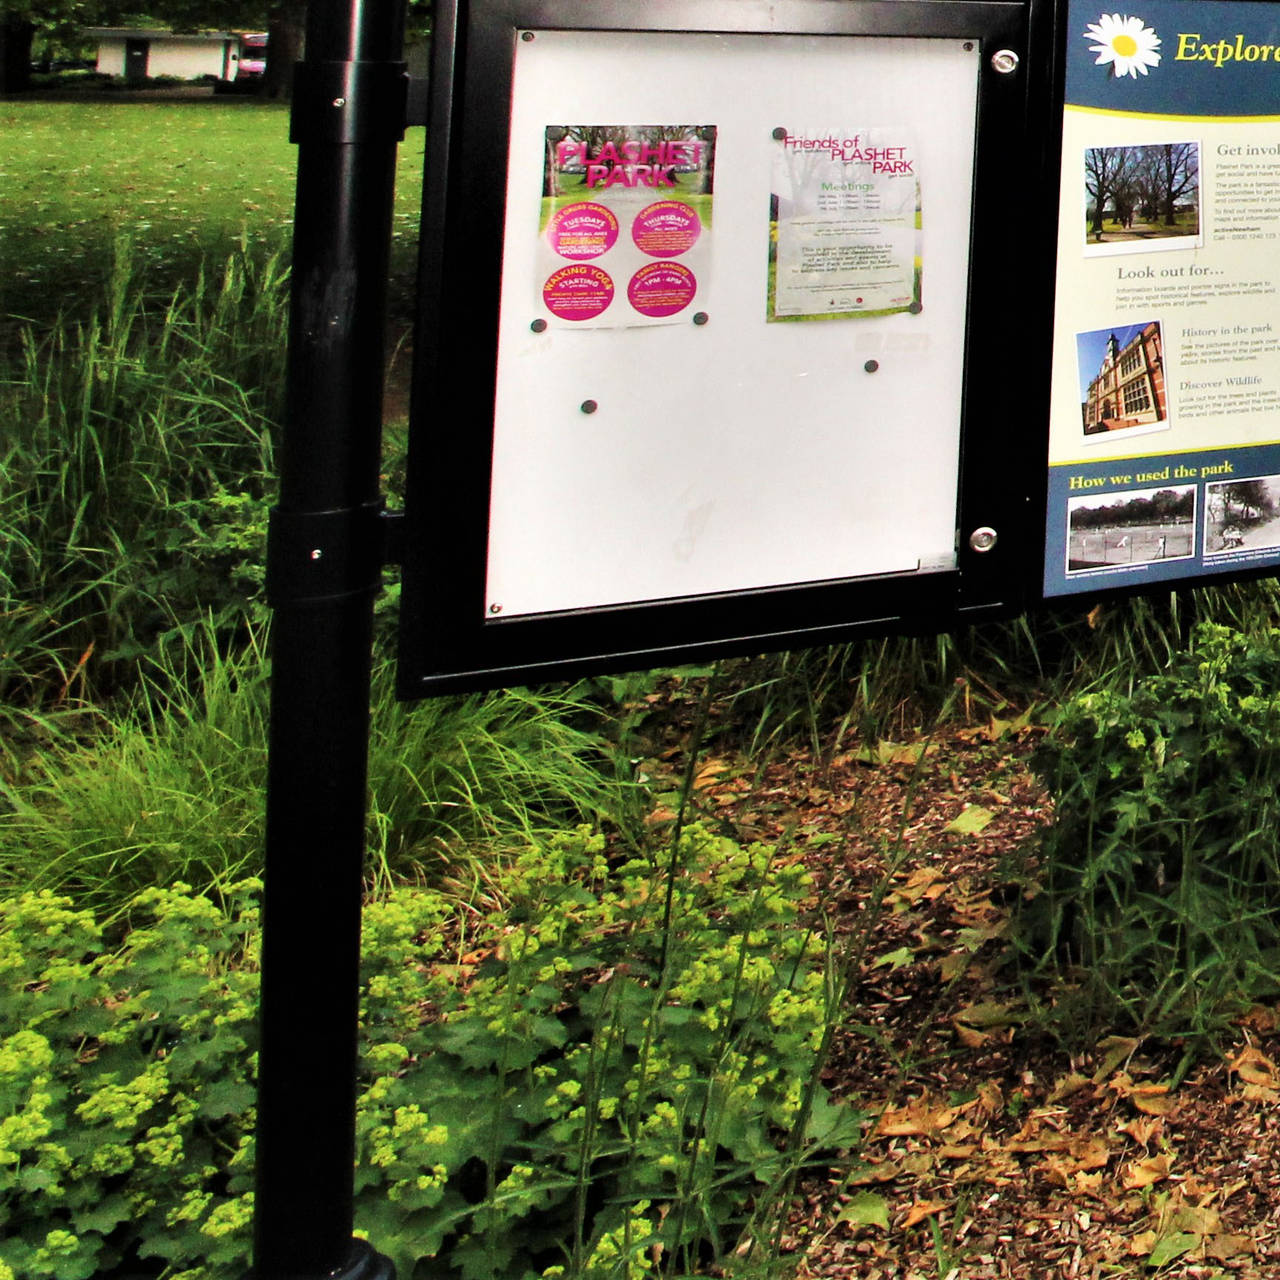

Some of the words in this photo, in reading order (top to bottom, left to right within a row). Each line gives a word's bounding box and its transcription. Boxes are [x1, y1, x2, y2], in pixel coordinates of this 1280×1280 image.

[783, 135, 839, 149] Friends
[843, 135, 860, 148] of
[555, 140, 708, 165] PLASHET
[831, 147, 906, 161] PLASHET
[1217, 144, 1241, 156] Get
[873, 160, 913, 174] PARK
[586, 164, 677, 188] PARK
[821, 182, 874, 192] Meetings
[563, 216, 605, 227] TUESDAYS
[644, 215, 690, 227] THURSDAYS
[544, 267, 587, 291] WALKING
[591, 269, 612, 290] YOGA
[1118, 266, 1155, 280] Look
[1160, 267, 1184, 277] out
[1189, 264, 1224, 276] for...
[559, 278, 599, 288] STARTING
[1182, 327, 1217, 337] History
[1221, 326, 1230, 334] in
[1233, 325, 1248, 334] the
[1251, 323, 1272, 334] park
[1180, 380, 1222, 390] Discover
[1226, 376, 1262, 385] Wildlife
[1069, 475, 1106, 490] How
[1110, 474, 1132, 485] we
[1136, 466, 1169, 483] used
[1174, 464, 1197, 479] the
[1201, 460, 1234, 479] park
